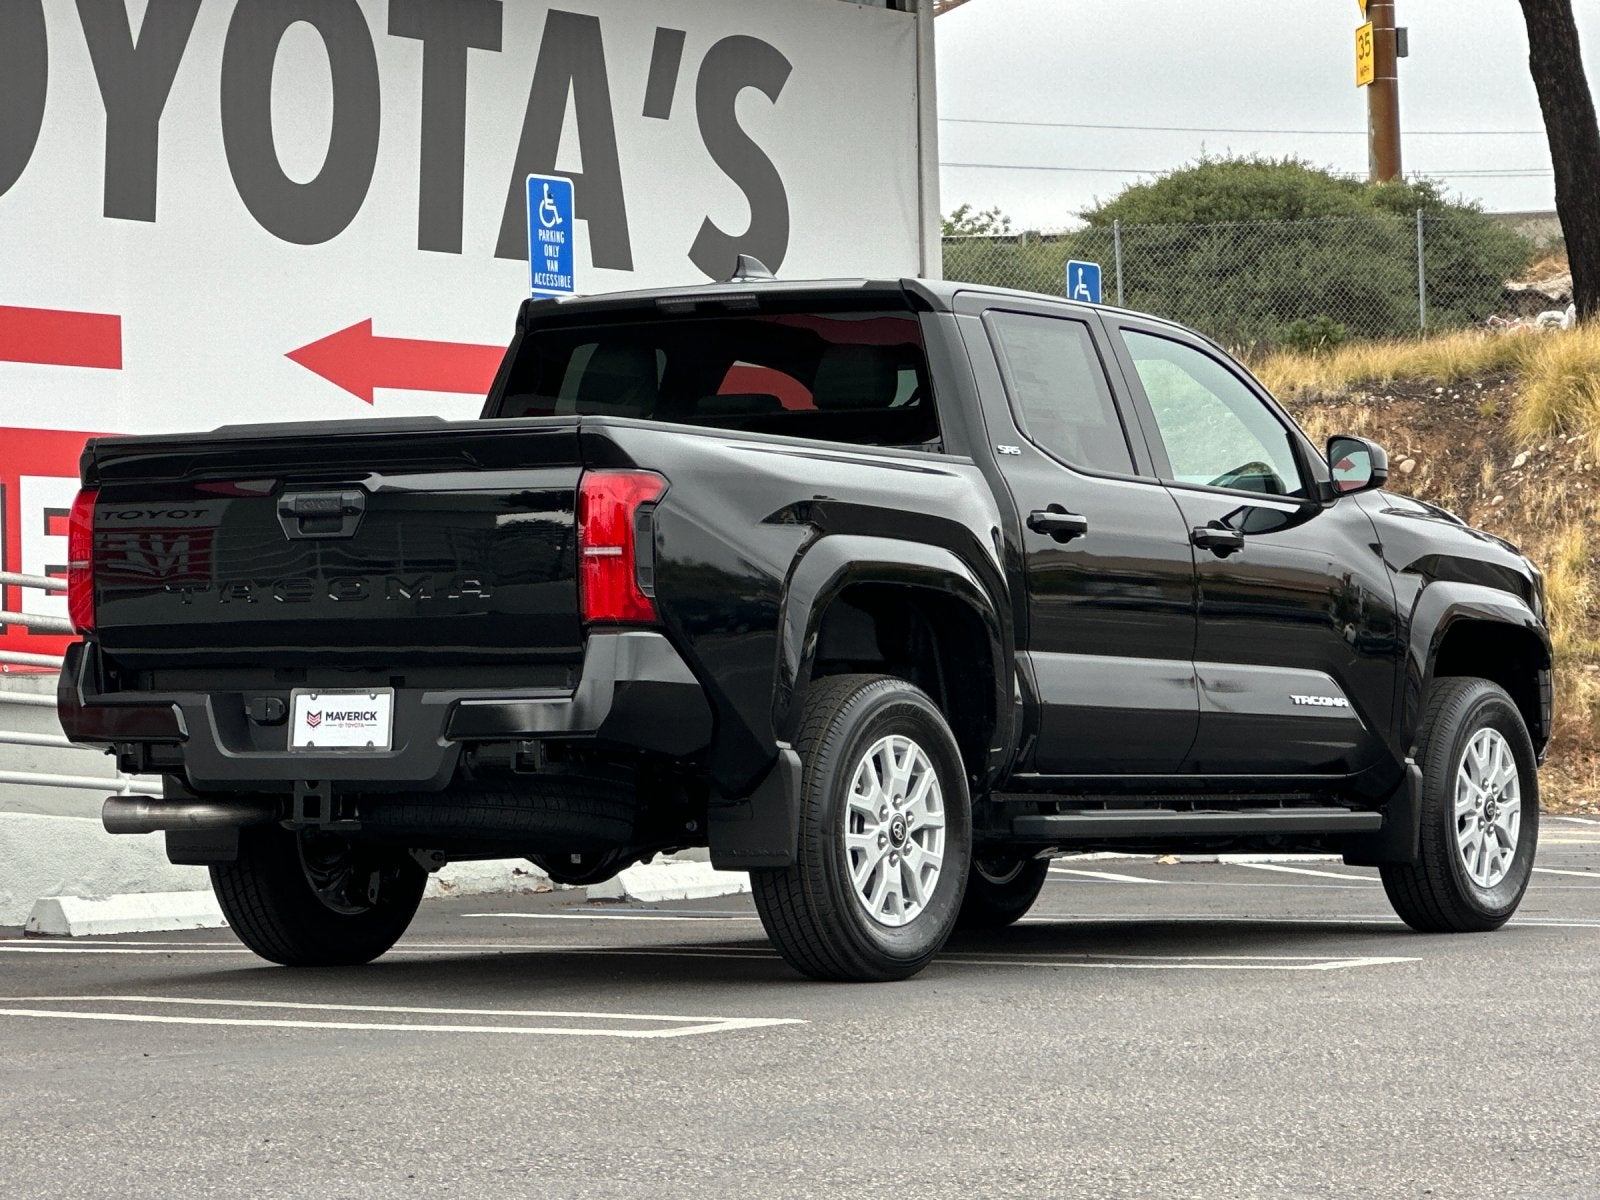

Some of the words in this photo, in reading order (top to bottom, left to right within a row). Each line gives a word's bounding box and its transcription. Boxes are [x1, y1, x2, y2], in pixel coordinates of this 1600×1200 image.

[1358, 31, 1371, 60] 35
[538, 229, 565, 244] PARKING
[544, 245, 560, 257] ONLY
[546, 259, 559, 272] VAN
[534, 272, 571, 288] ACCESSIBLE
[997, 444, 1021, 455] SR5
[164, 576, 496, 604] TACOMA
[1289, 694, 1349, 707] TACOMA
[325, 711, 377, 721] MAVERICK
